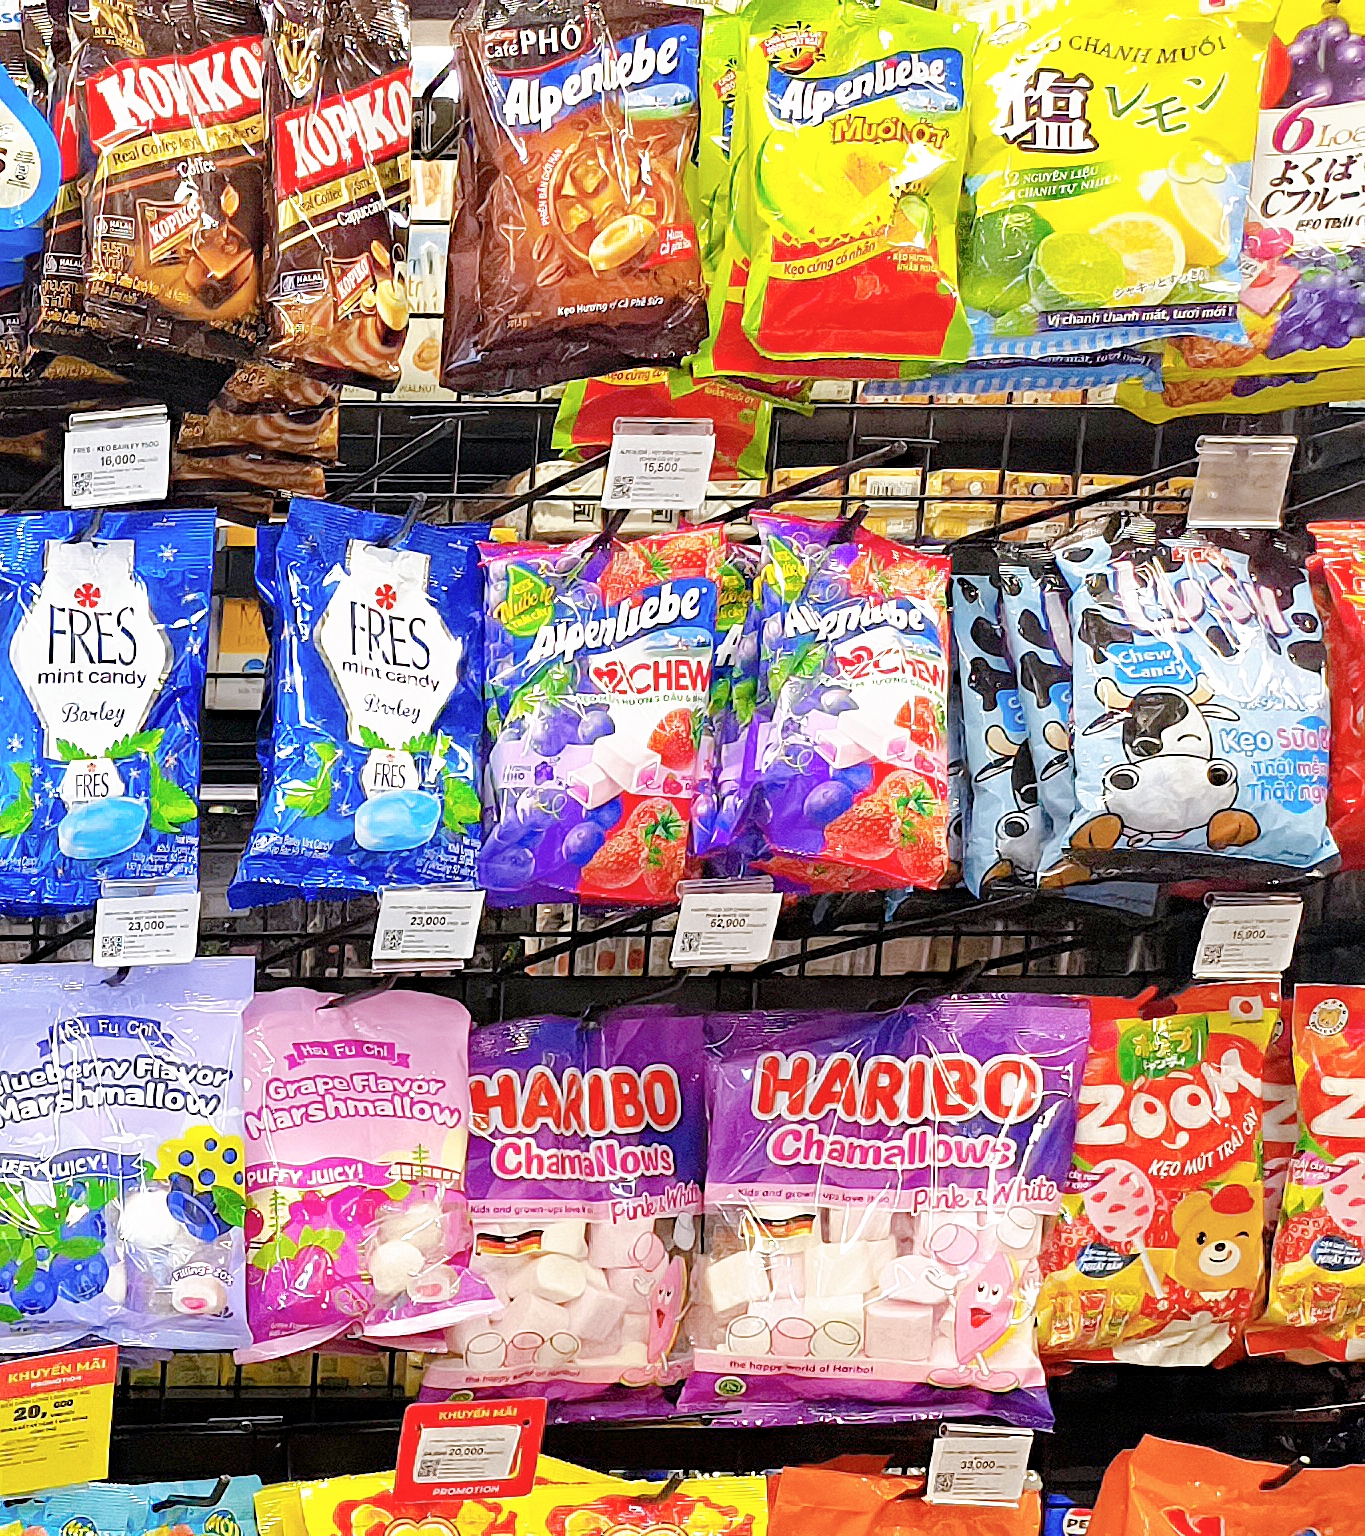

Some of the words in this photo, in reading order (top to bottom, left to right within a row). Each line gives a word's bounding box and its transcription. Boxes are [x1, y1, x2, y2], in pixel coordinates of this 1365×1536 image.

[484, 37, 519, 59] Café
[520, 19, 585, 55] PHỐ
[1069, 35, 1151, 65] CHANH
[98, 48, 260, 123] KOPIKO
[503, 36, 681, 131] Alpenliebe
[778, 56, 946, 124] Alpenliebe
[995, 70, 1099, 154] 塩
[1105, 72, 1228, 132] レモン
[287, 77, 412, 178] KOPIKO
[1273, 106, 1314, 152] 6
[783, 261, 807, 277] Kẹo
[1063, 310, 1101, 326] chanh
[1104, 308, 1139, 325] thanh
[49, 606, 137, 666] FRES
[352, 602, 430, 670] FRES
[529, 586, 704, 663] Alpenliebe
[37, 670, 83, 686] mint
[89, 670, 147, 689] candy
[343, 659, 379, 681] mint
[382, 670, 440, 692] candy
[61, 702, 126, 726] Barley
[1220, 728, 1273, 757] Kẹo
[76, 773, 109, 798] FRES
[374, 763, 406, 788] FRES
[128, 920, 164, 932] 23,000
[410, 916, 446, 927] 23,000
[301, 1043, 328, 1059] Hsu
[338, 1042, 357, 1057] Fu
[363, 1042, 388, 1058] Chi
[134, 1051, 231, 1087] Flavor
[269, 1075, 350, 1102] Grape
[353, 1072, 445, 1098] Flavor
[470, 1067, 680, 1136] HARIBO
[756, 1053, 1042, 1124] HARIBO
[246, 1096, 462, 1140] Marshmallow
[494, 1141, 675, 1180] Chamallows
[767, 1129, 1016, 1171] Chamallows
[247, 1165, 308, 1185] PUFFY
[310, 1162, 364, 1184] JUICY!
[610, 1193, 657, 1224] Pink
[912, 1184, 965, 1219] Pink
[992, 1180, 1058, 1206] White
[77, 1357, 107, 1378] MÃI
[432, 1484, 499, 1497] PROMOTION
